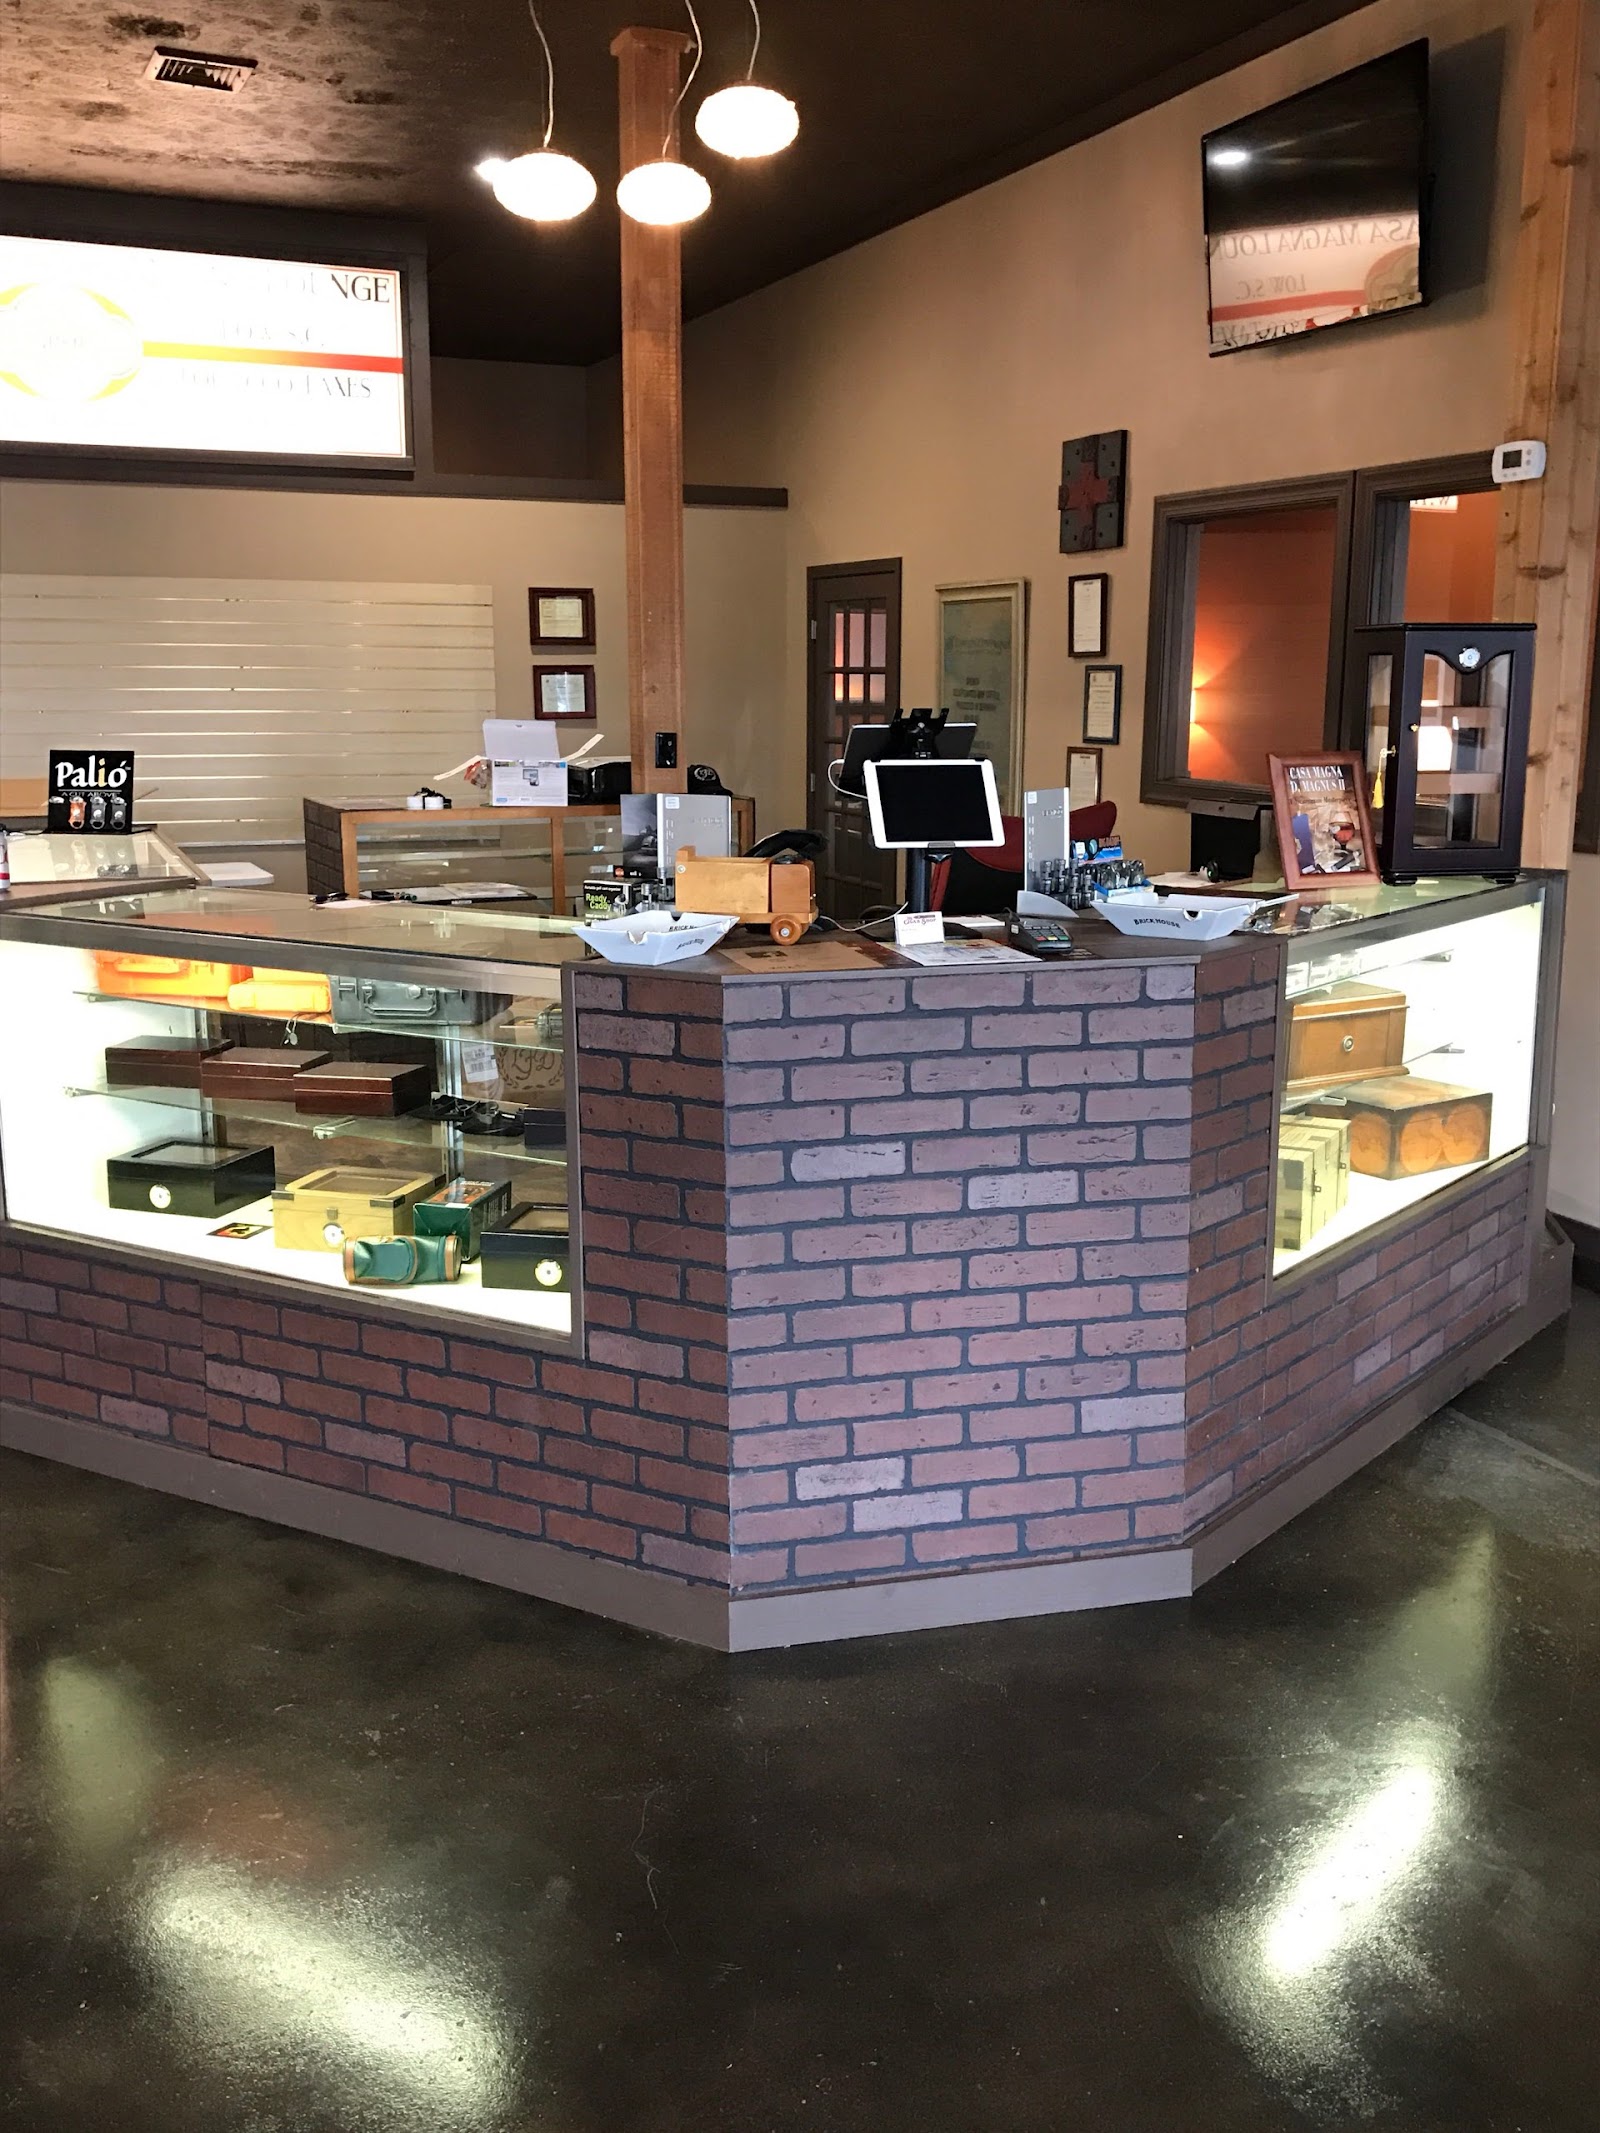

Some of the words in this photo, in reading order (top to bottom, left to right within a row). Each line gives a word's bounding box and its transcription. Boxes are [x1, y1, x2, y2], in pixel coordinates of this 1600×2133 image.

[1289, 767, 1311, 779] CASA
[1313, 766, 1343, 778] MAGNA
[1303, 779, 1337, 792] MAGNUS
[585, 893, 607, 903] Ready
[589, 901, 612, 911] Caddy
[1155, 919, 1181, 928] HOUSE
